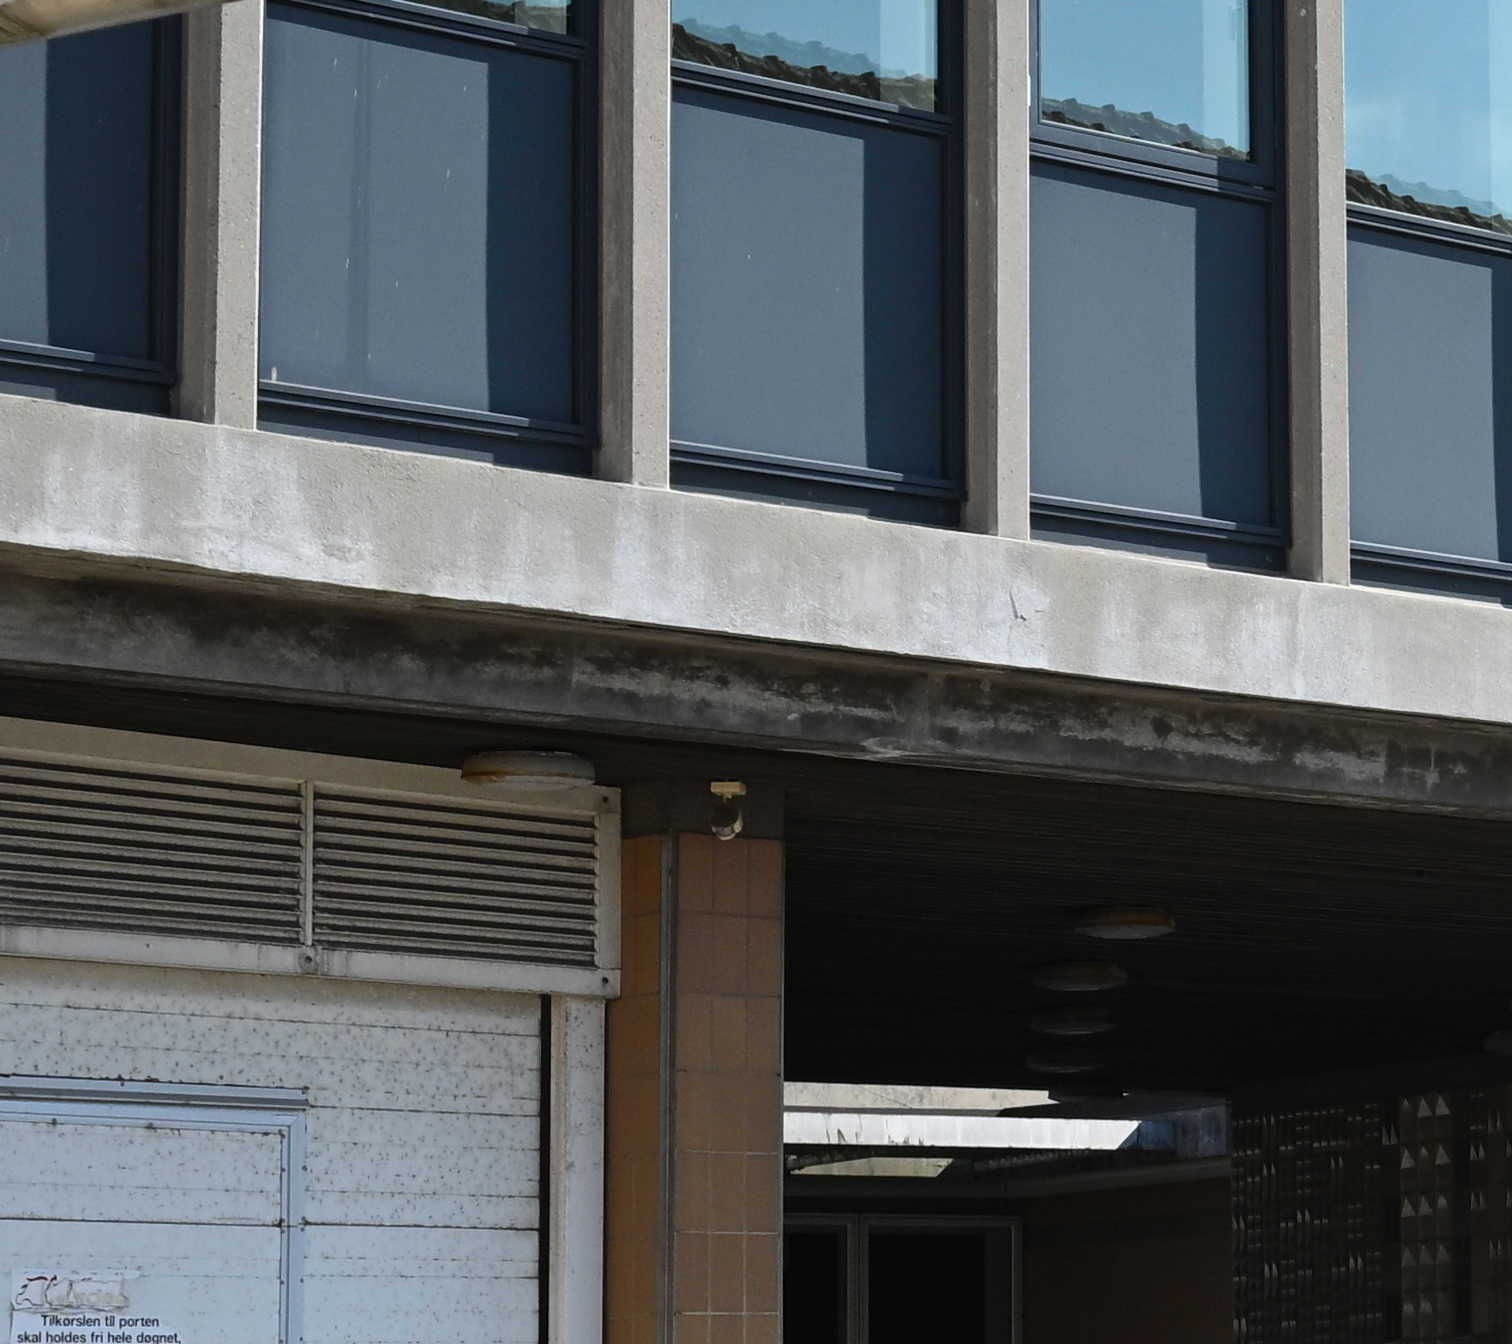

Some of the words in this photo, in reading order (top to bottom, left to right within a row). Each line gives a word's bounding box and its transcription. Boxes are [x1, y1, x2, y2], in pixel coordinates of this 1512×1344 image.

[105, 1315, 115, 1327] til
[119, 1315, 160, 1329] porten
[17, 1331, 42, 1344] skal
[45, 1331, 87, 1344] holdes
[91, 1331, 104, 1344] fri
[107, 1331, 133, 1344] hele
